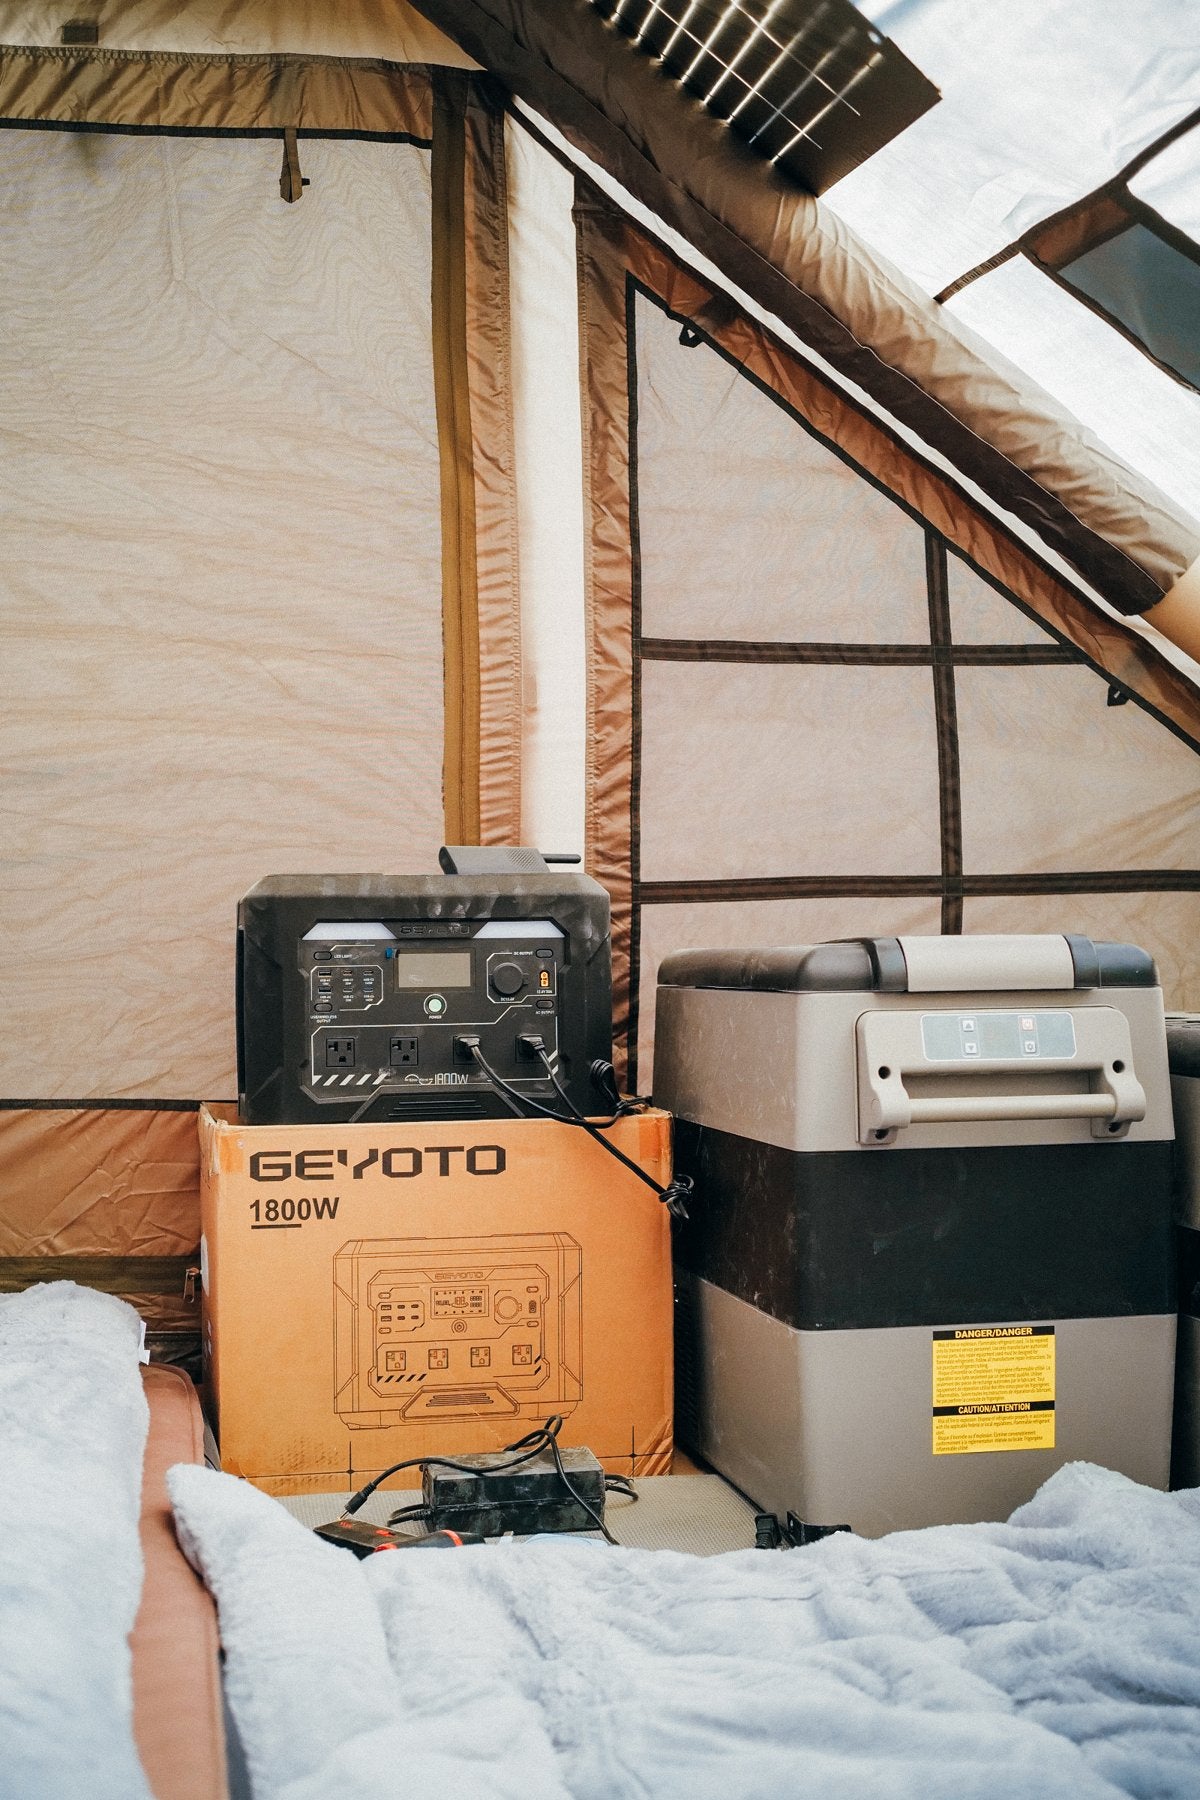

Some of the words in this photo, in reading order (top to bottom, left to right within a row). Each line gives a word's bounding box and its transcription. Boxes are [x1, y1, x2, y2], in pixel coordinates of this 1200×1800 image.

[434, 1072, 469, 1085] 1800W
[249, 1144, 507, 1183] GEYOTO
[249, 1196, 340, 1222] 1800W
[954, 1327, 1033, 1339] DANGER/DANGER
[958, 1402, 1031, 1415] CAUTION/ATTENTION
